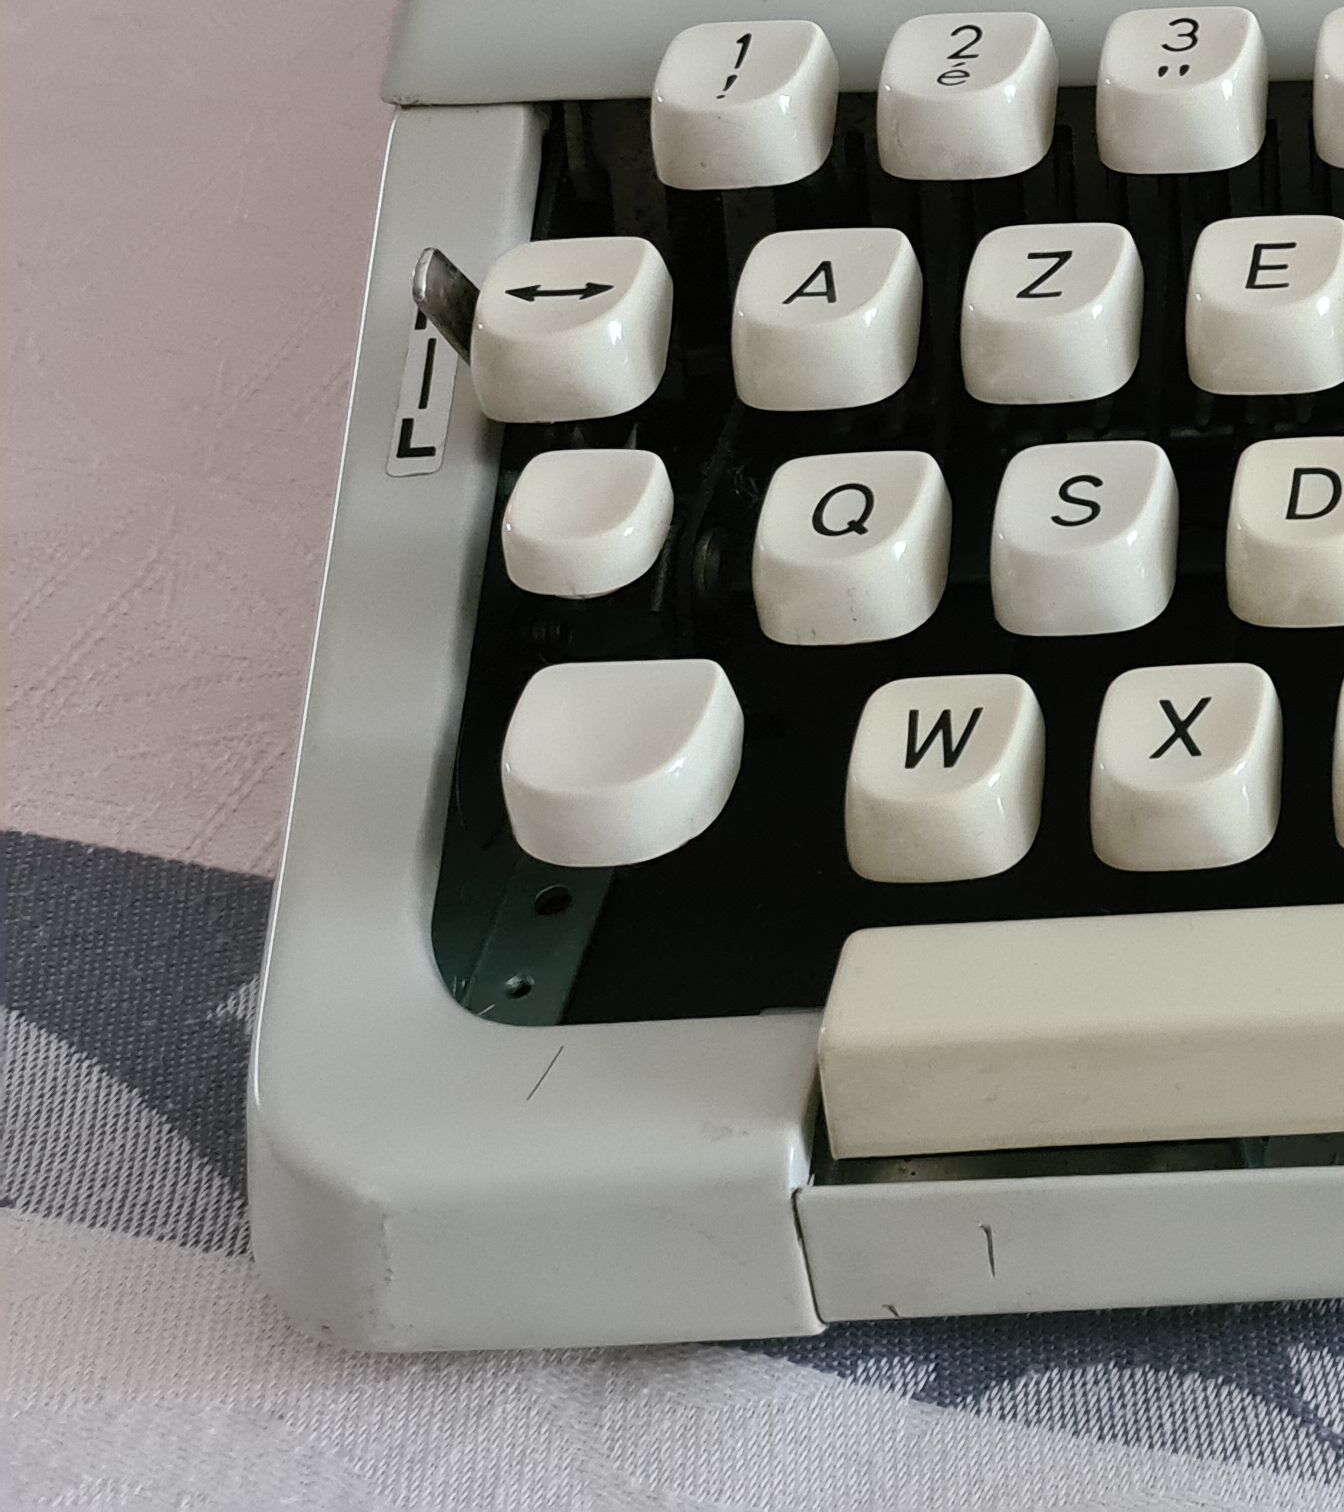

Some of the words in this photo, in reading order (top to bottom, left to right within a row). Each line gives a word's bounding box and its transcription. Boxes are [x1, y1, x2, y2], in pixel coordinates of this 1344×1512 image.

[733, 32, 753, 70] 1
[946, 24, 984, 60] 2
[1160, 17, 1200, 53] 3
[781, 260, 838, 305] A
[1015, 249, 1074, 299] Z
[1244, 241, 1298, 290] E
[811, 482, 875, 537] Q
[1050, 474, 1104, 528] S
[1284, 466, 1343, 521] D
[904, 706, 984, 770] W
[1148, 696, 1213, 760] X
